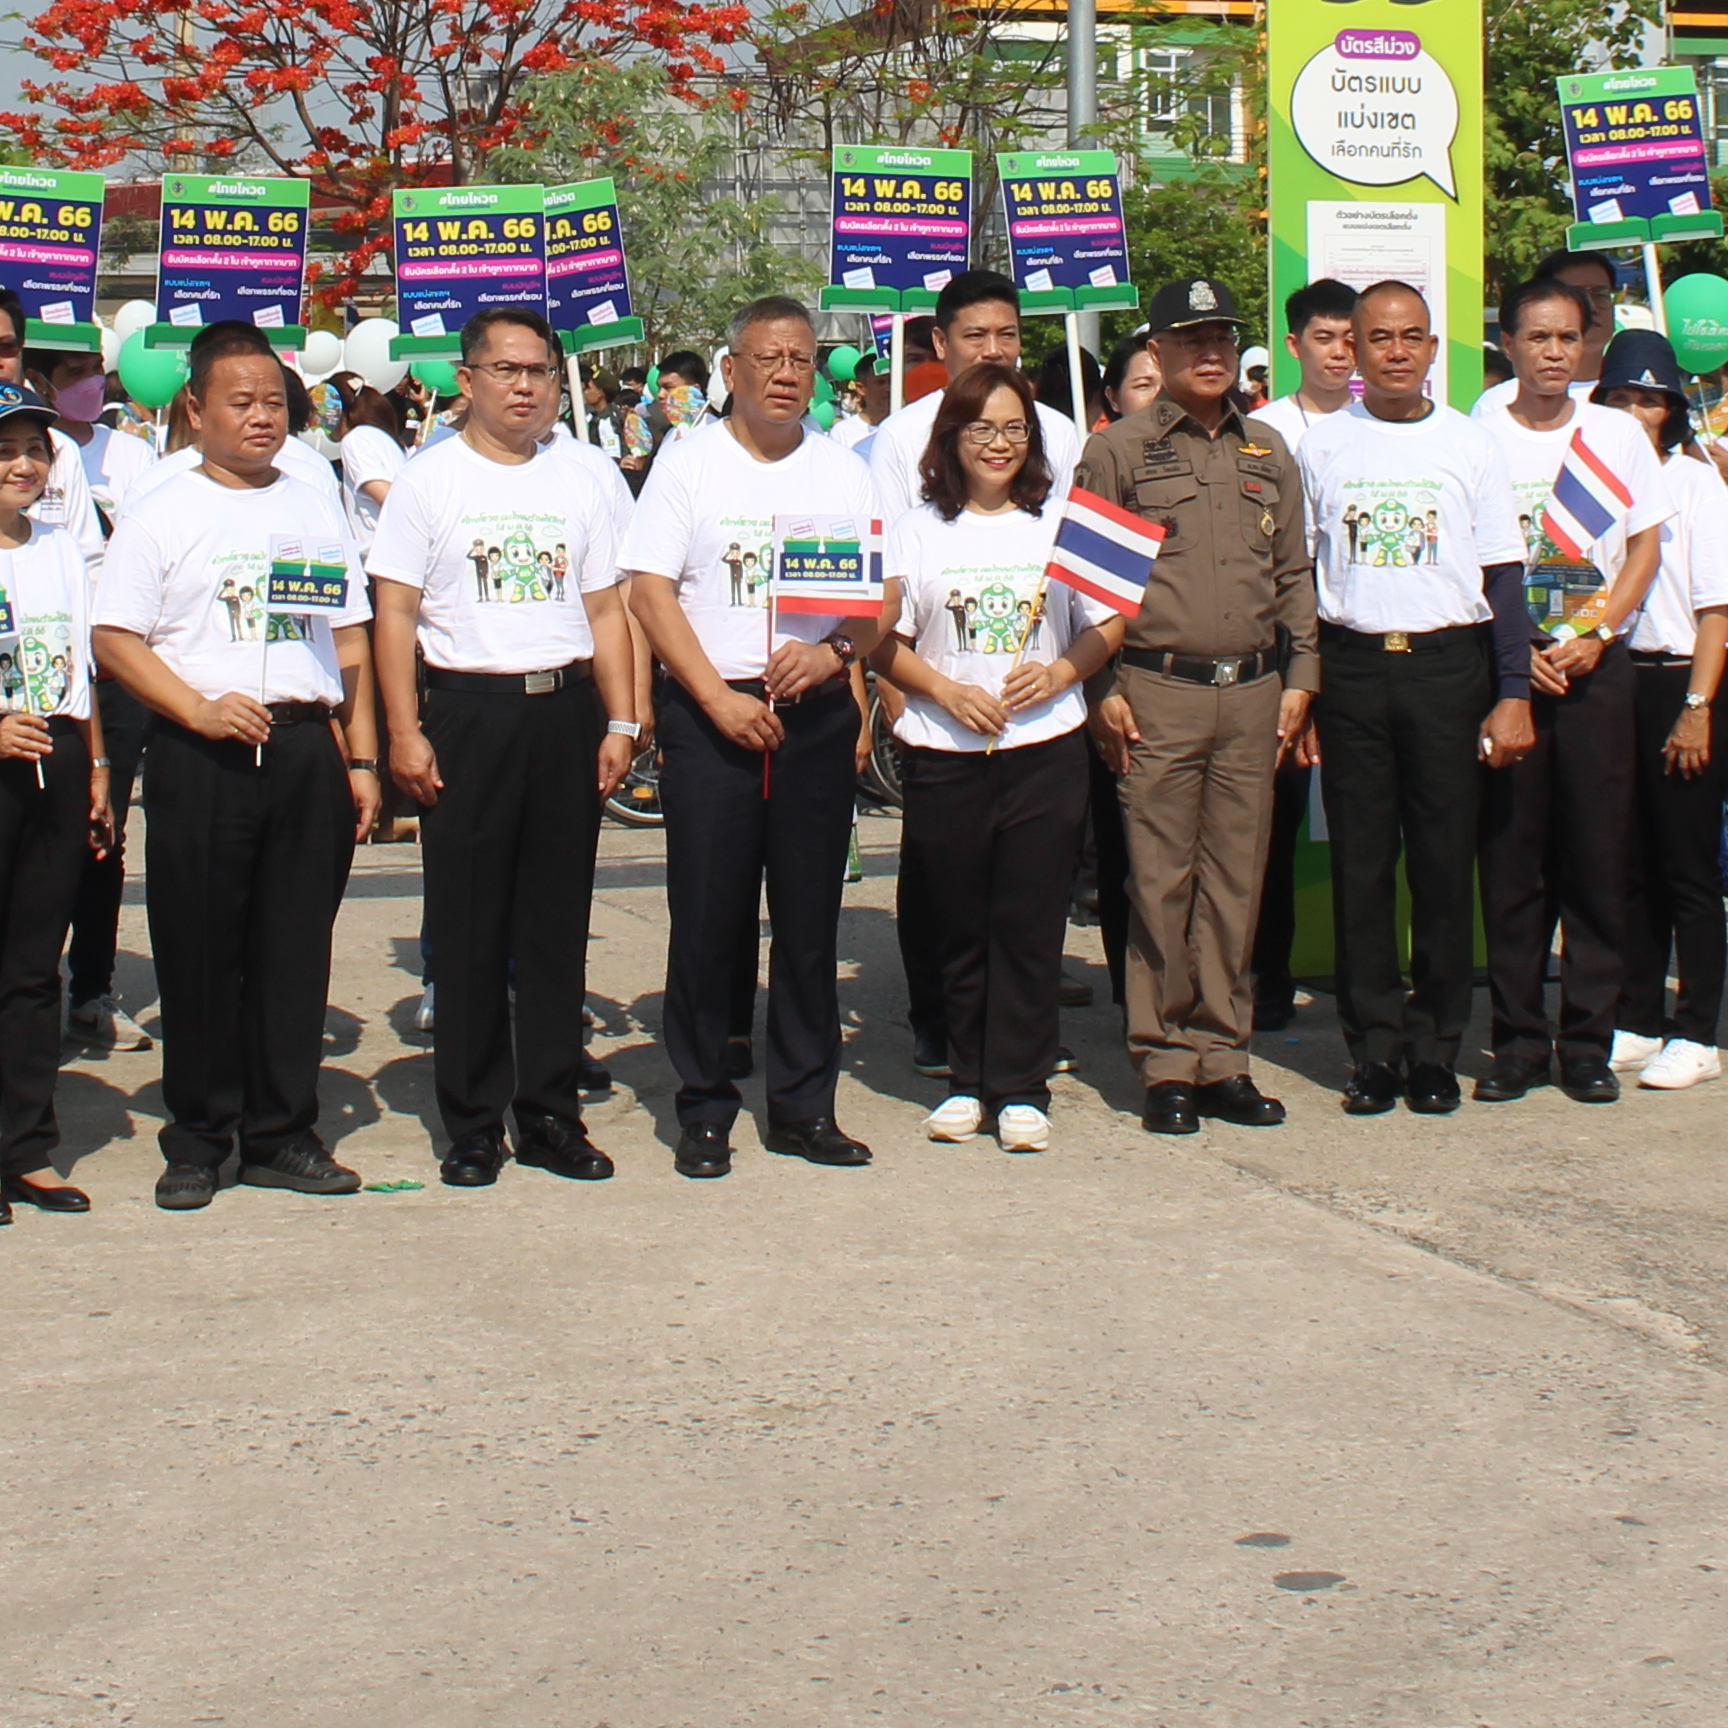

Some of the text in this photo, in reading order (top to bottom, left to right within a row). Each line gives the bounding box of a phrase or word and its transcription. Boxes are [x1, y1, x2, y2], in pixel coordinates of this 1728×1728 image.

[1340, 33, 1416, 56] บัตรสีม่วง
[1330, 68, 1423, 94] บัตรแบบ
[1337, 104, 1417, 131] แบ่งเขต
[1571, 98, 1694, 129] 14 พ.ค. 66
[1330, 135, 1424, 160] เลือกคนที่รัก
[840, 176, 964, 201] 14 พ.ค. 66
[1010, 178, 1112, 202] 14 พ.ค. 66
[56, 204, 93, 228] 66
[168, 207, 300, 233] 14 พ.ค. 66
[582, 210, 612, 233] 66
[402, 217, 536, 242] 14 พ.ค. 66
[785, 558, 858, 570] 14 พ.ค. 66
[271, 580, 342, 596] 14 พ.ค. 66
